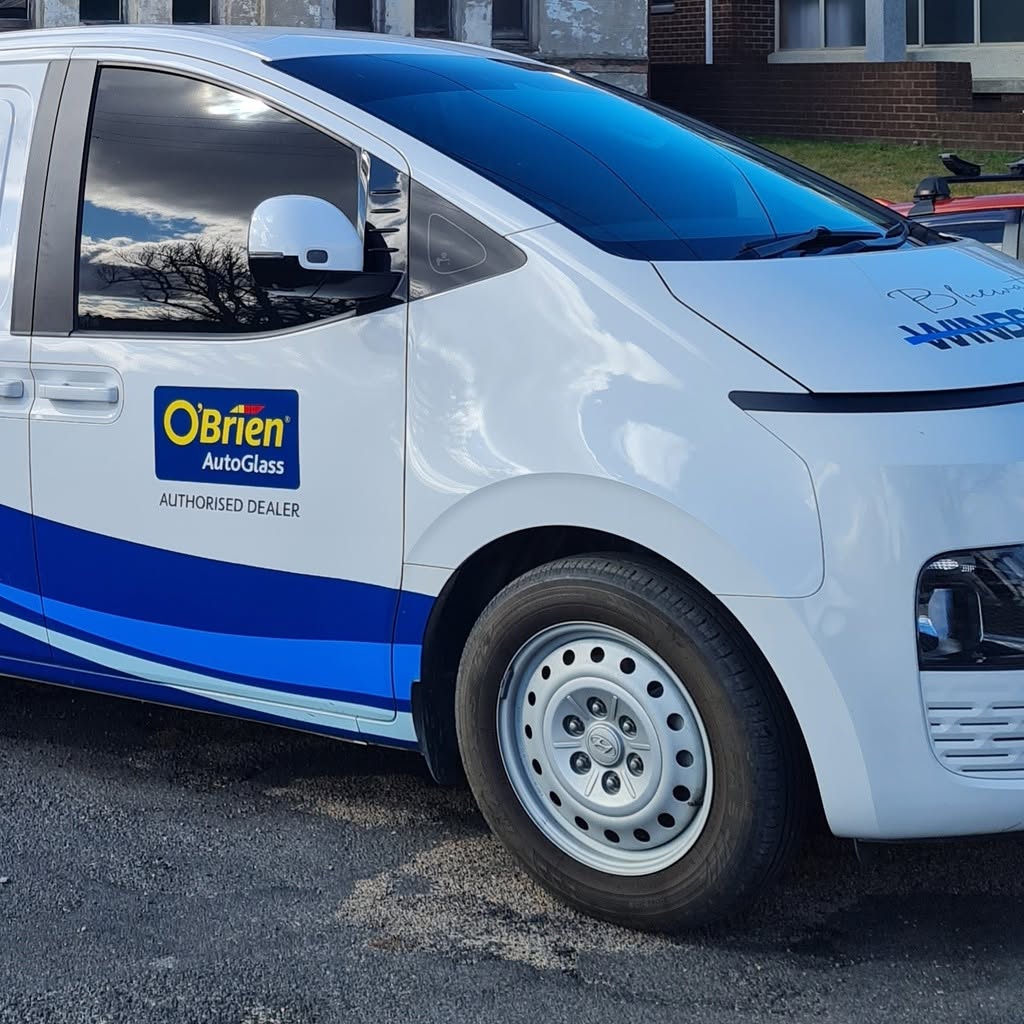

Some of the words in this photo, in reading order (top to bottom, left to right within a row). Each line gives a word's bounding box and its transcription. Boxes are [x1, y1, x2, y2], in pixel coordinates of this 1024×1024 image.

[202, 451, 285, 475] AutoGlass
[159, 492, 244, 513] AUTHORISED
[247, 499, 300, 518] DEALER
